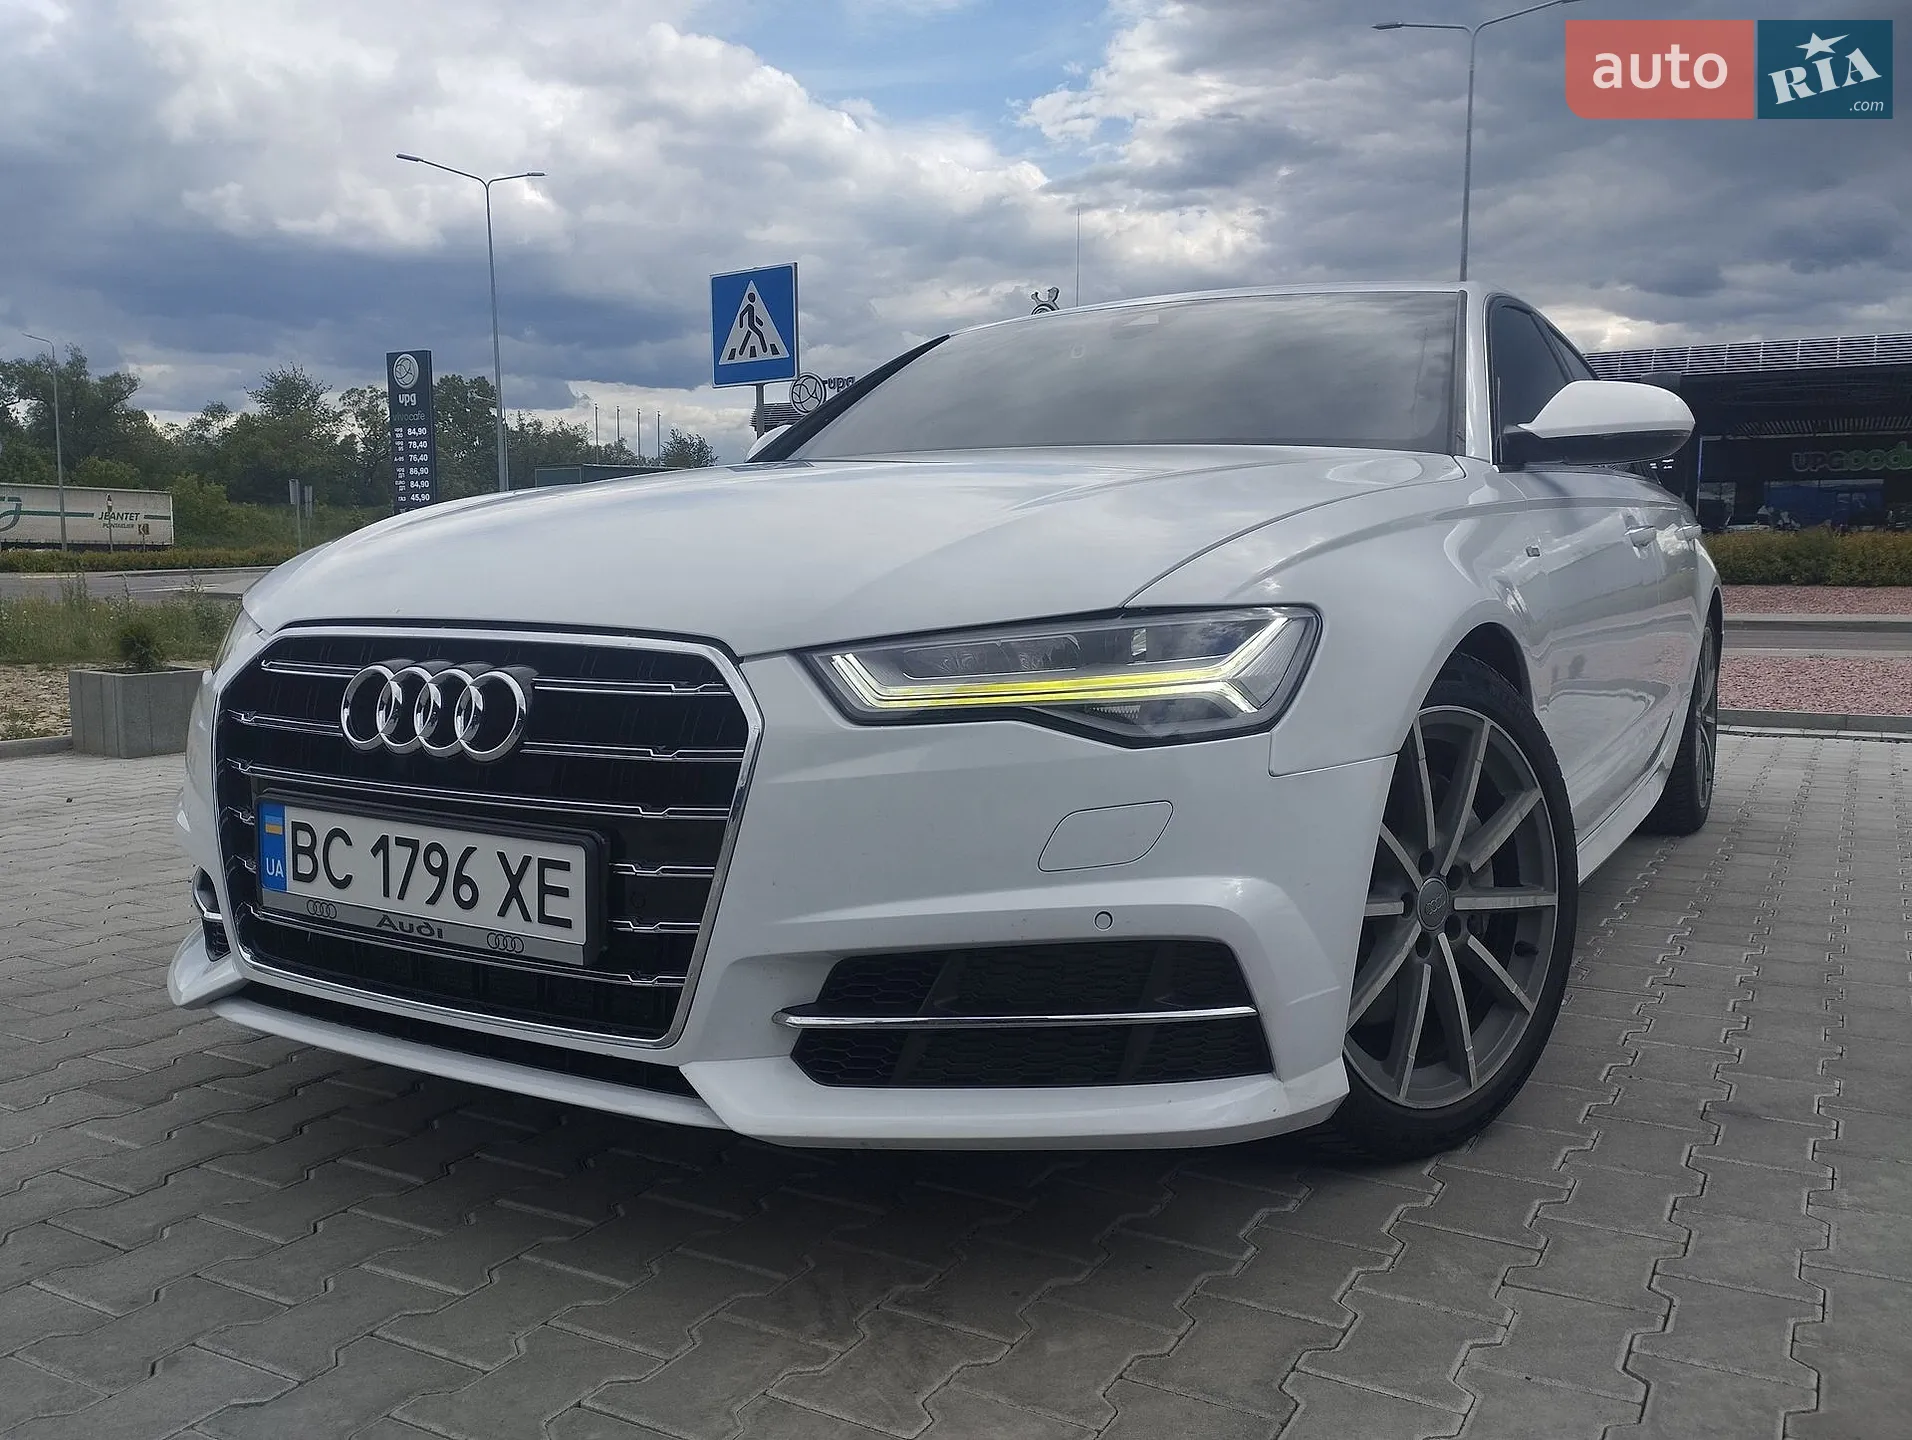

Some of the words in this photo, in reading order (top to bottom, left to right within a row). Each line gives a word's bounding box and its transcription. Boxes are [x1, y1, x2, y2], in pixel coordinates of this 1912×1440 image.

[398, 393, 417, 406] upg
[407, 427, 427, 437] 84,90
[408, 441, 428, 450] 78,40
[409, 454, 428, 463] 76,40
[410, 480, 430, 489] 84,90
[410, 493, 430, 502] 45,90
[98, 511, 140, 521] JEANTET
[266, 856, 284, 878] UA
[291, 820, 353, 890] BC
[370, 834, 480, 911] 1796
[497, 850, 573, 929] XE
[376, 914, 444, 939] Audi
